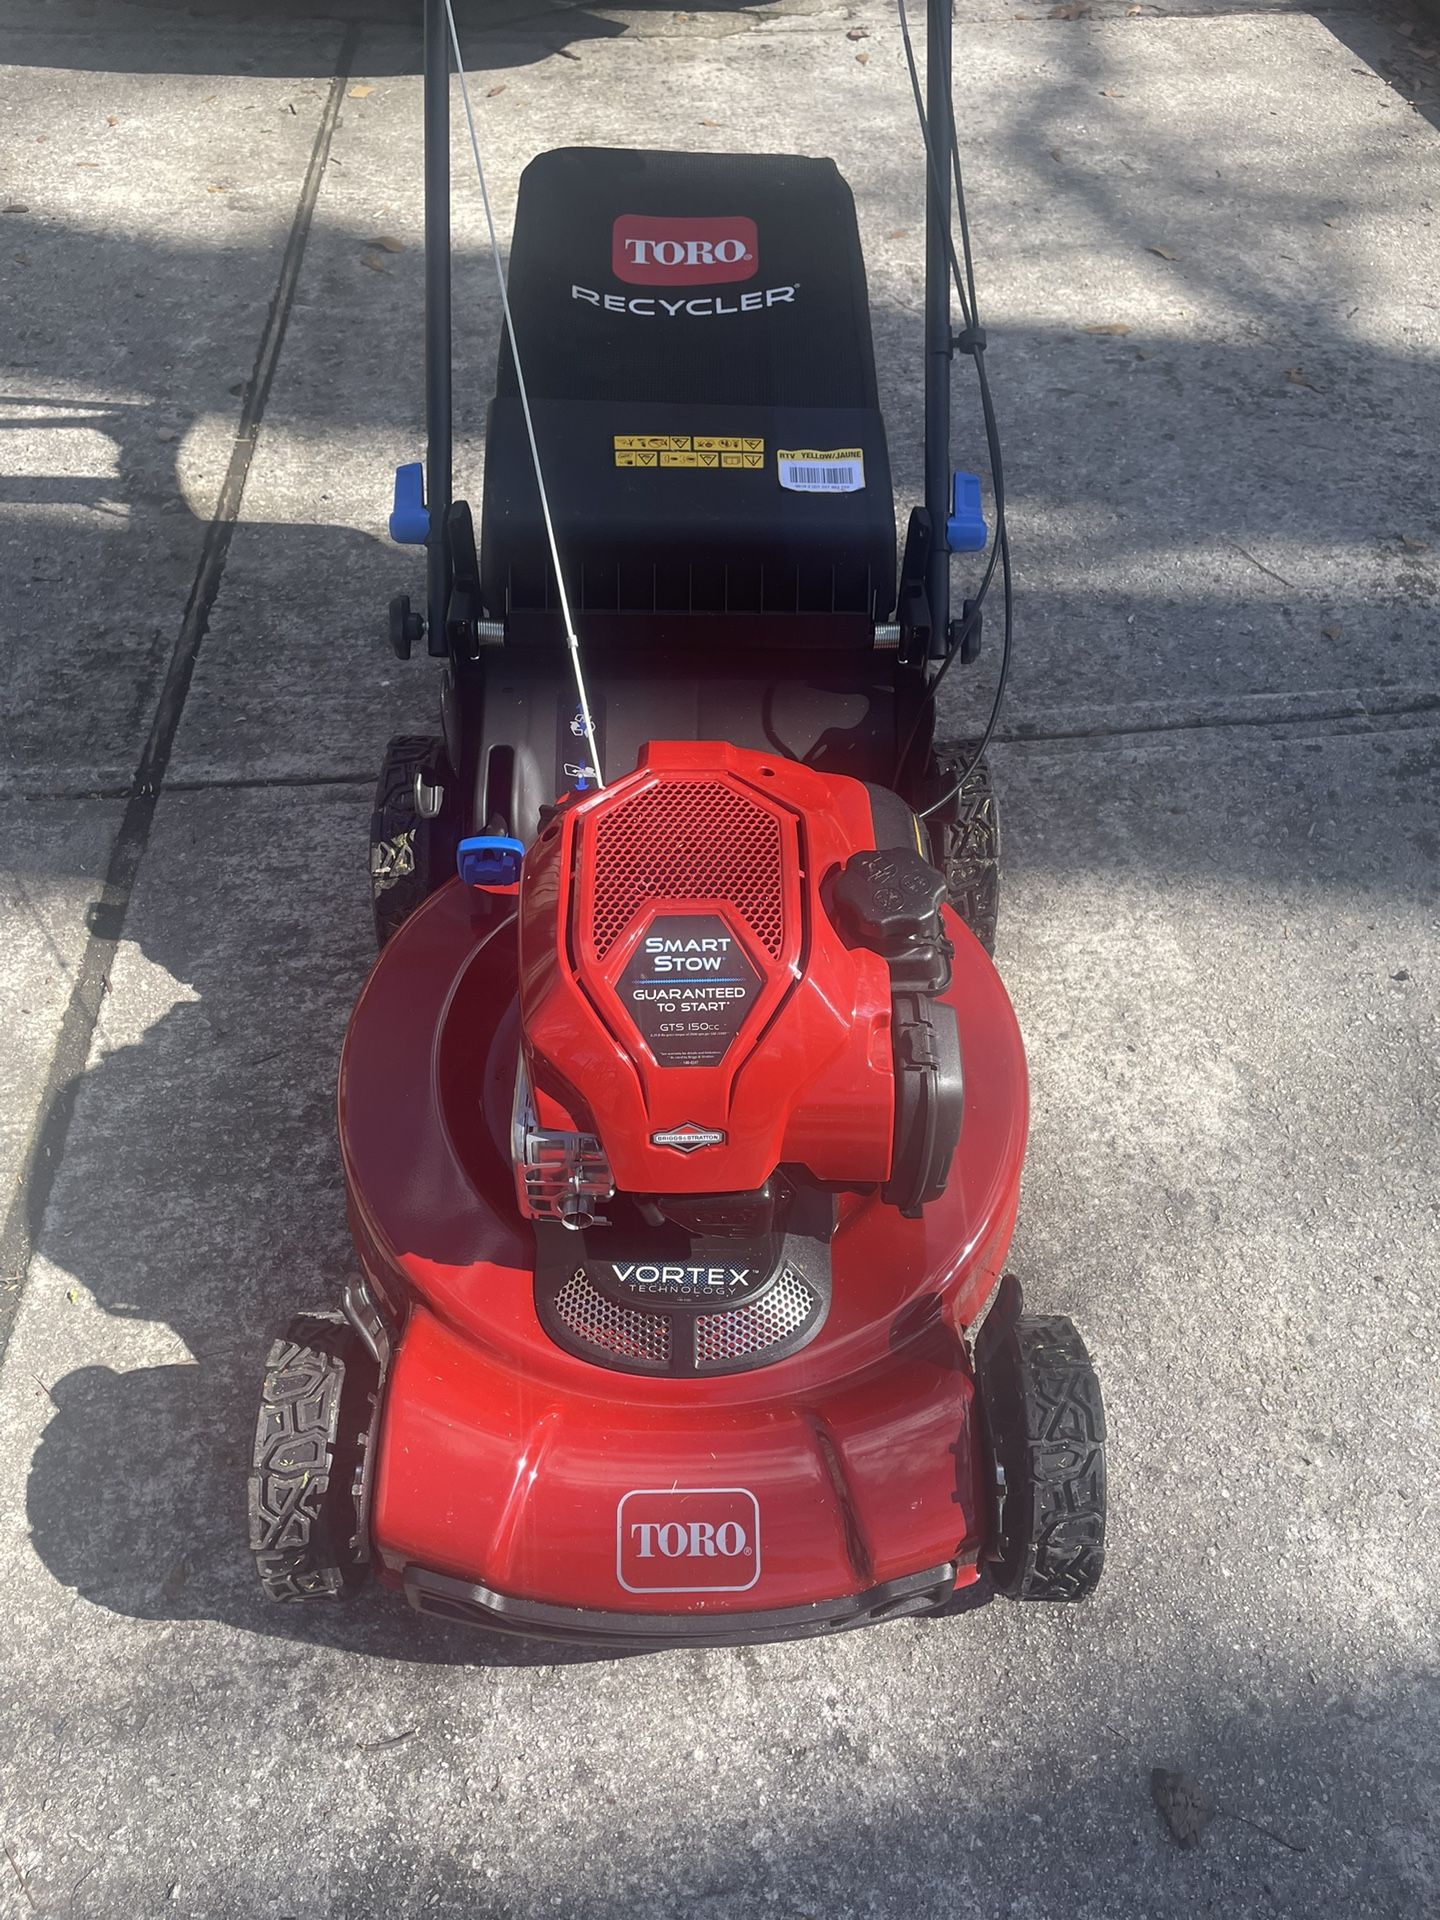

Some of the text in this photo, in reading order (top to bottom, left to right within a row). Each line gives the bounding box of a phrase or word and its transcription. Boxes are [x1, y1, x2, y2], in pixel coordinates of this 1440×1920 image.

[625, 239, 747, 266] TORO
[572, 283, 797, 316] RECYCLER
[800, 450, 862, 460] YELLOW/JAUNE
[645, 937, 731, 953] SMART
[654, 955, 722, 972] STOW
[633, 986, 746, 1001] GUARANTEED
[657, 1002, 676, 1013] TO
[660, 1023, 685, 1032] GTS
[611, 1264, 750, 1286] VORTEX
[629, 1284, 737, 1296] TECHNOLOGY
[631, 1521, 747, 1558] TORO
